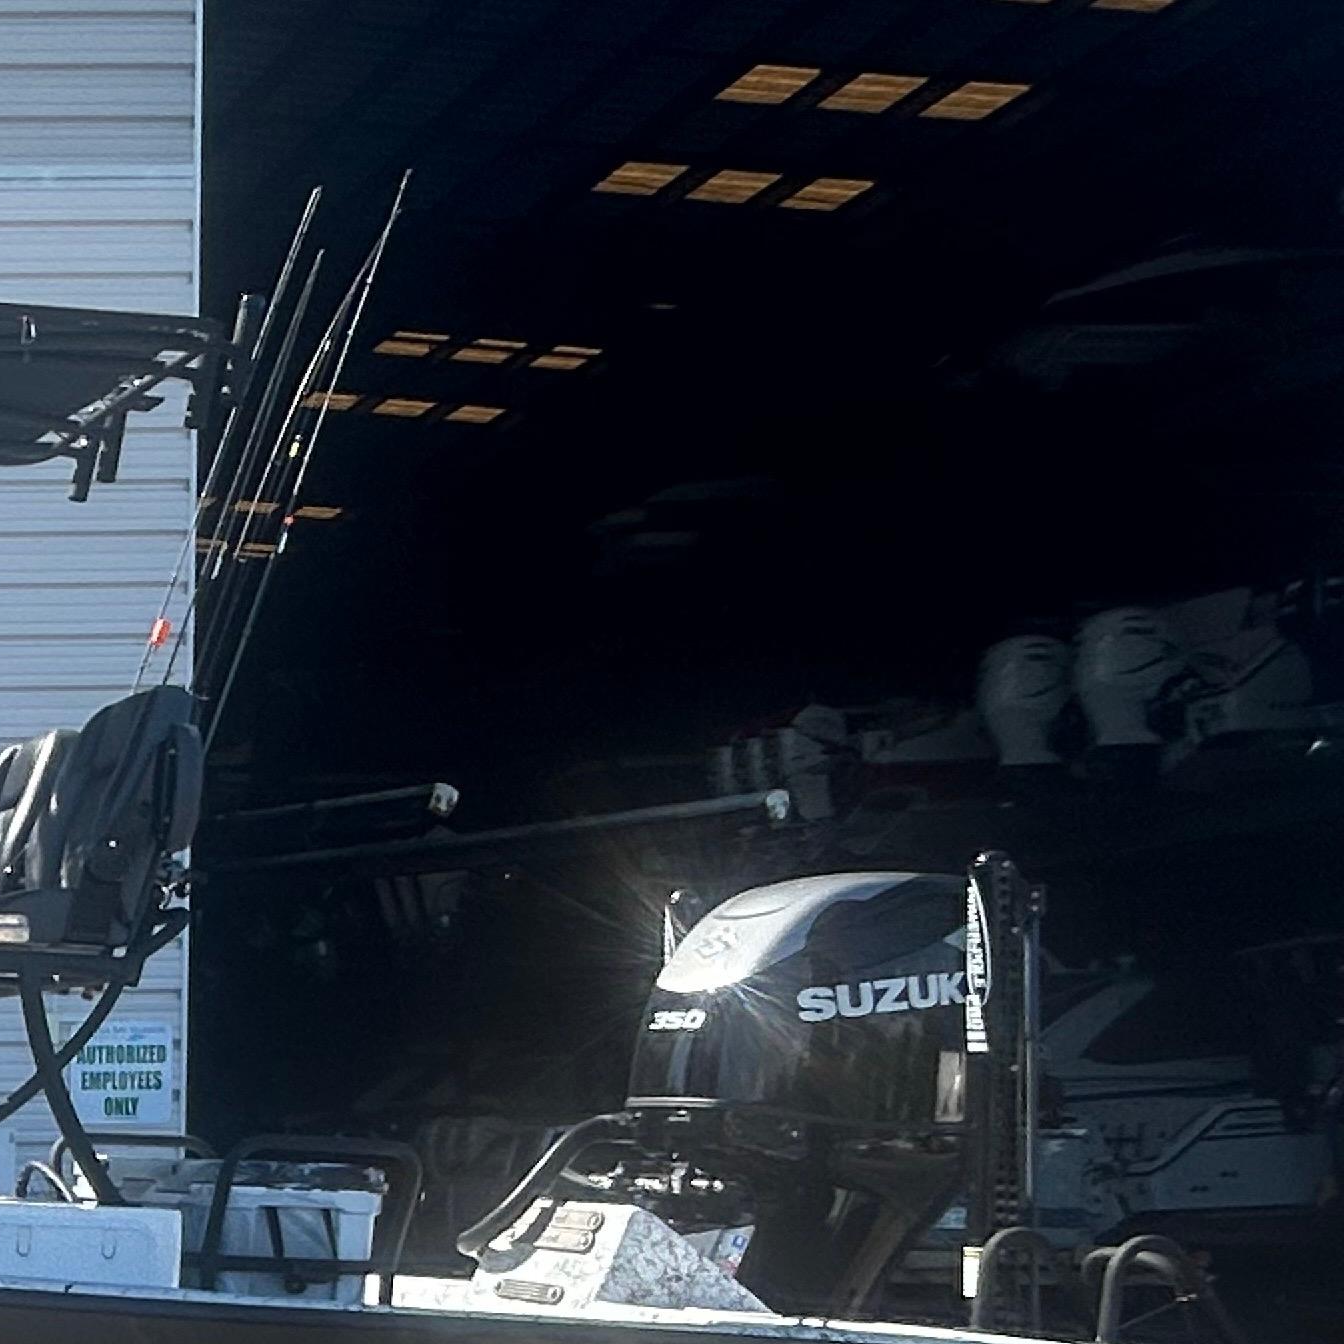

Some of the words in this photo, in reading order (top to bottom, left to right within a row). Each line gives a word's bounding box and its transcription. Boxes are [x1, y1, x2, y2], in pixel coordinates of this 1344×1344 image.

[796, 970, 967, 1024] SUZUK
[77, 1044, 167, 1065] AUTHORIZED
[80, 1070, 163, 1092] EMPLOYEES
[104, 1096, 140, 1117] ONLY
